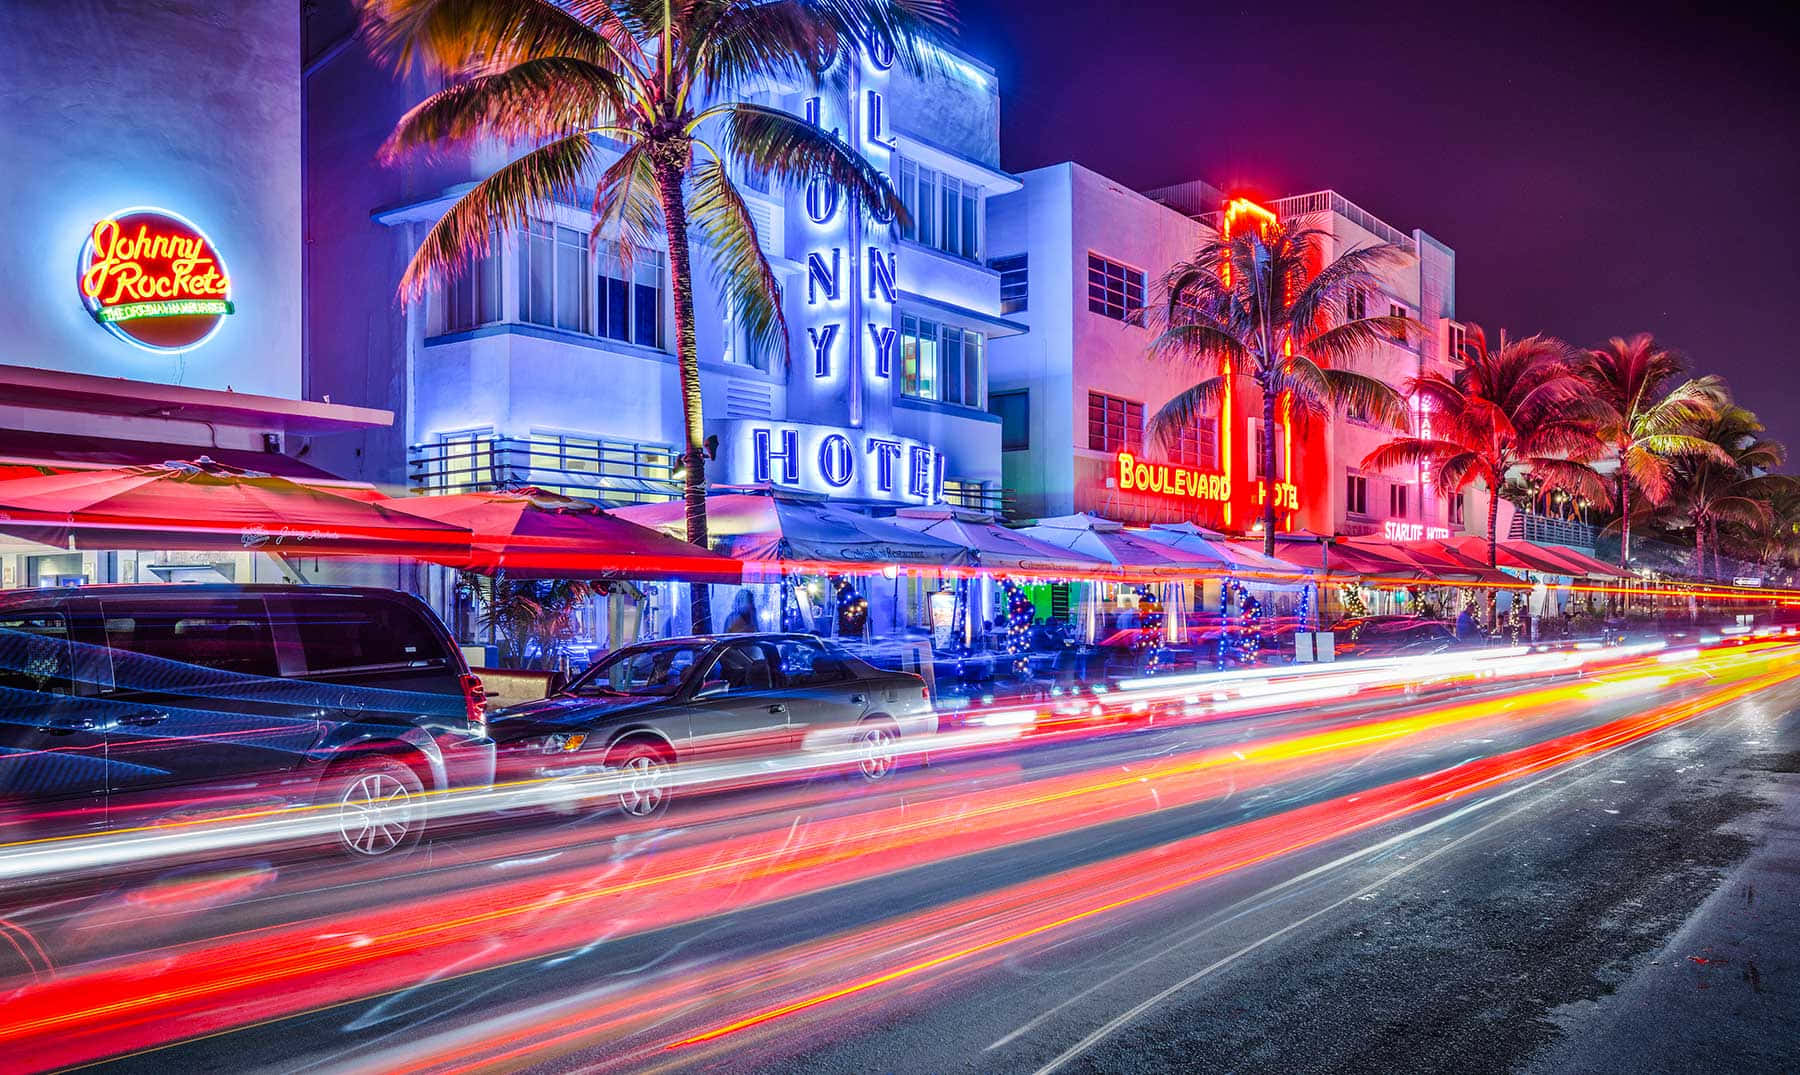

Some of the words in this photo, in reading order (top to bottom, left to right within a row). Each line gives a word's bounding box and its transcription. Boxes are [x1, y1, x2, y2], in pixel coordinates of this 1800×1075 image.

[83, 220, 212, 297] Johnny
[105, 261, 230, 304] Rockets
[1421, 395, 1432, 483] STARTE
[1119, 453, 1231, 501] BOULEVARD
